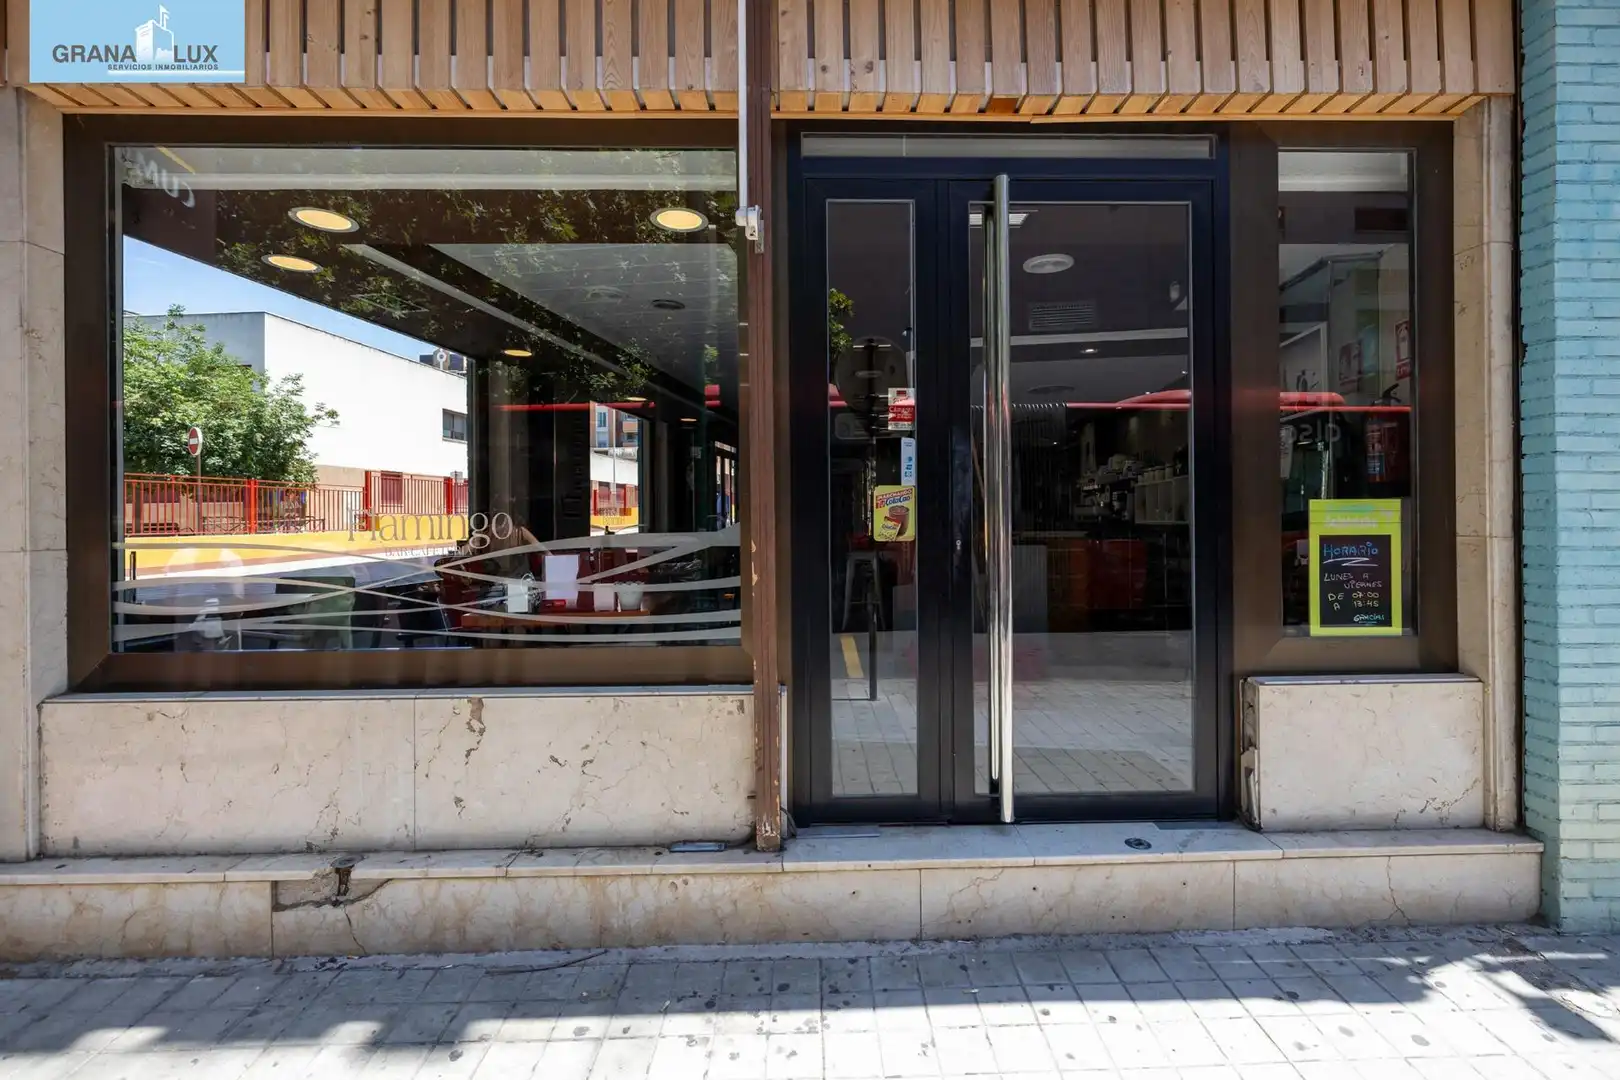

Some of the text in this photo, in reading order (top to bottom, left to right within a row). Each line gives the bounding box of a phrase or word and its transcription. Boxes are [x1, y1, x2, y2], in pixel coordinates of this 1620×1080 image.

[347, 505, 513, 549] Flamingo
[1327, 592, 1345, 601] DE
[1333, 602, 1341, 611] A
